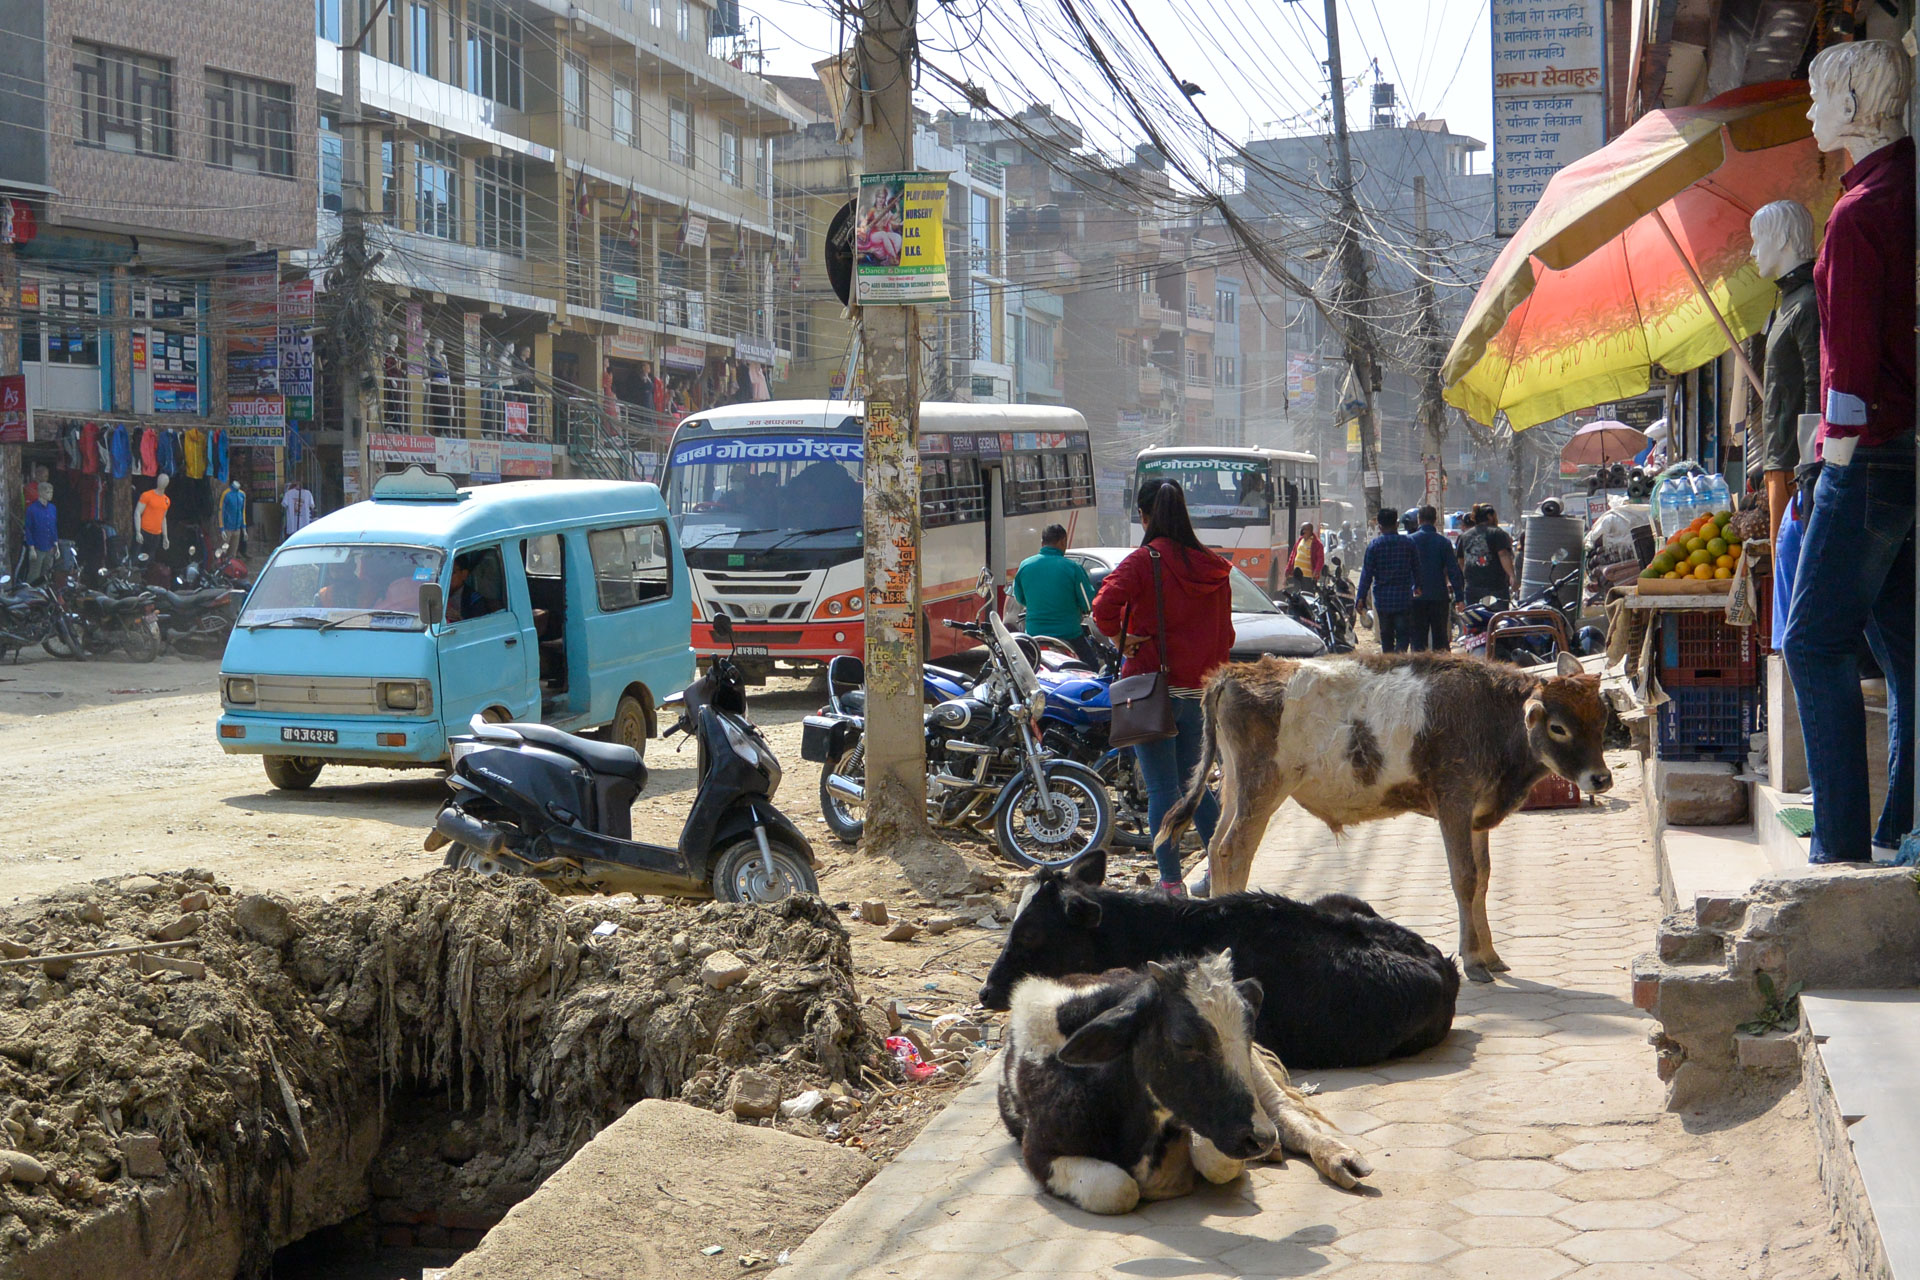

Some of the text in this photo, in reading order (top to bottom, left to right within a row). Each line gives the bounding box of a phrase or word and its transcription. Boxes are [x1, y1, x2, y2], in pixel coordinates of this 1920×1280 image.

[1495, 71, 1538, 88] अन्य
[1505, 97, 1529, 111] खोप
[1533, 96, 1573, 110] कार्यक्रम
[1506, 114, 1540, 128] परिवार
[1543, 113, 1583, 126] नियोजन
[1541, 130, 1560, 143] सेवा
[1534, 147, 1555, 160] सेवा
[905, 208, 933, 219] NURSERY
[229, 426, 283, 437] COMPUTER
[371, 434, 435, 450] Bangkok House
[676, 444, 713, 464] बाबा
